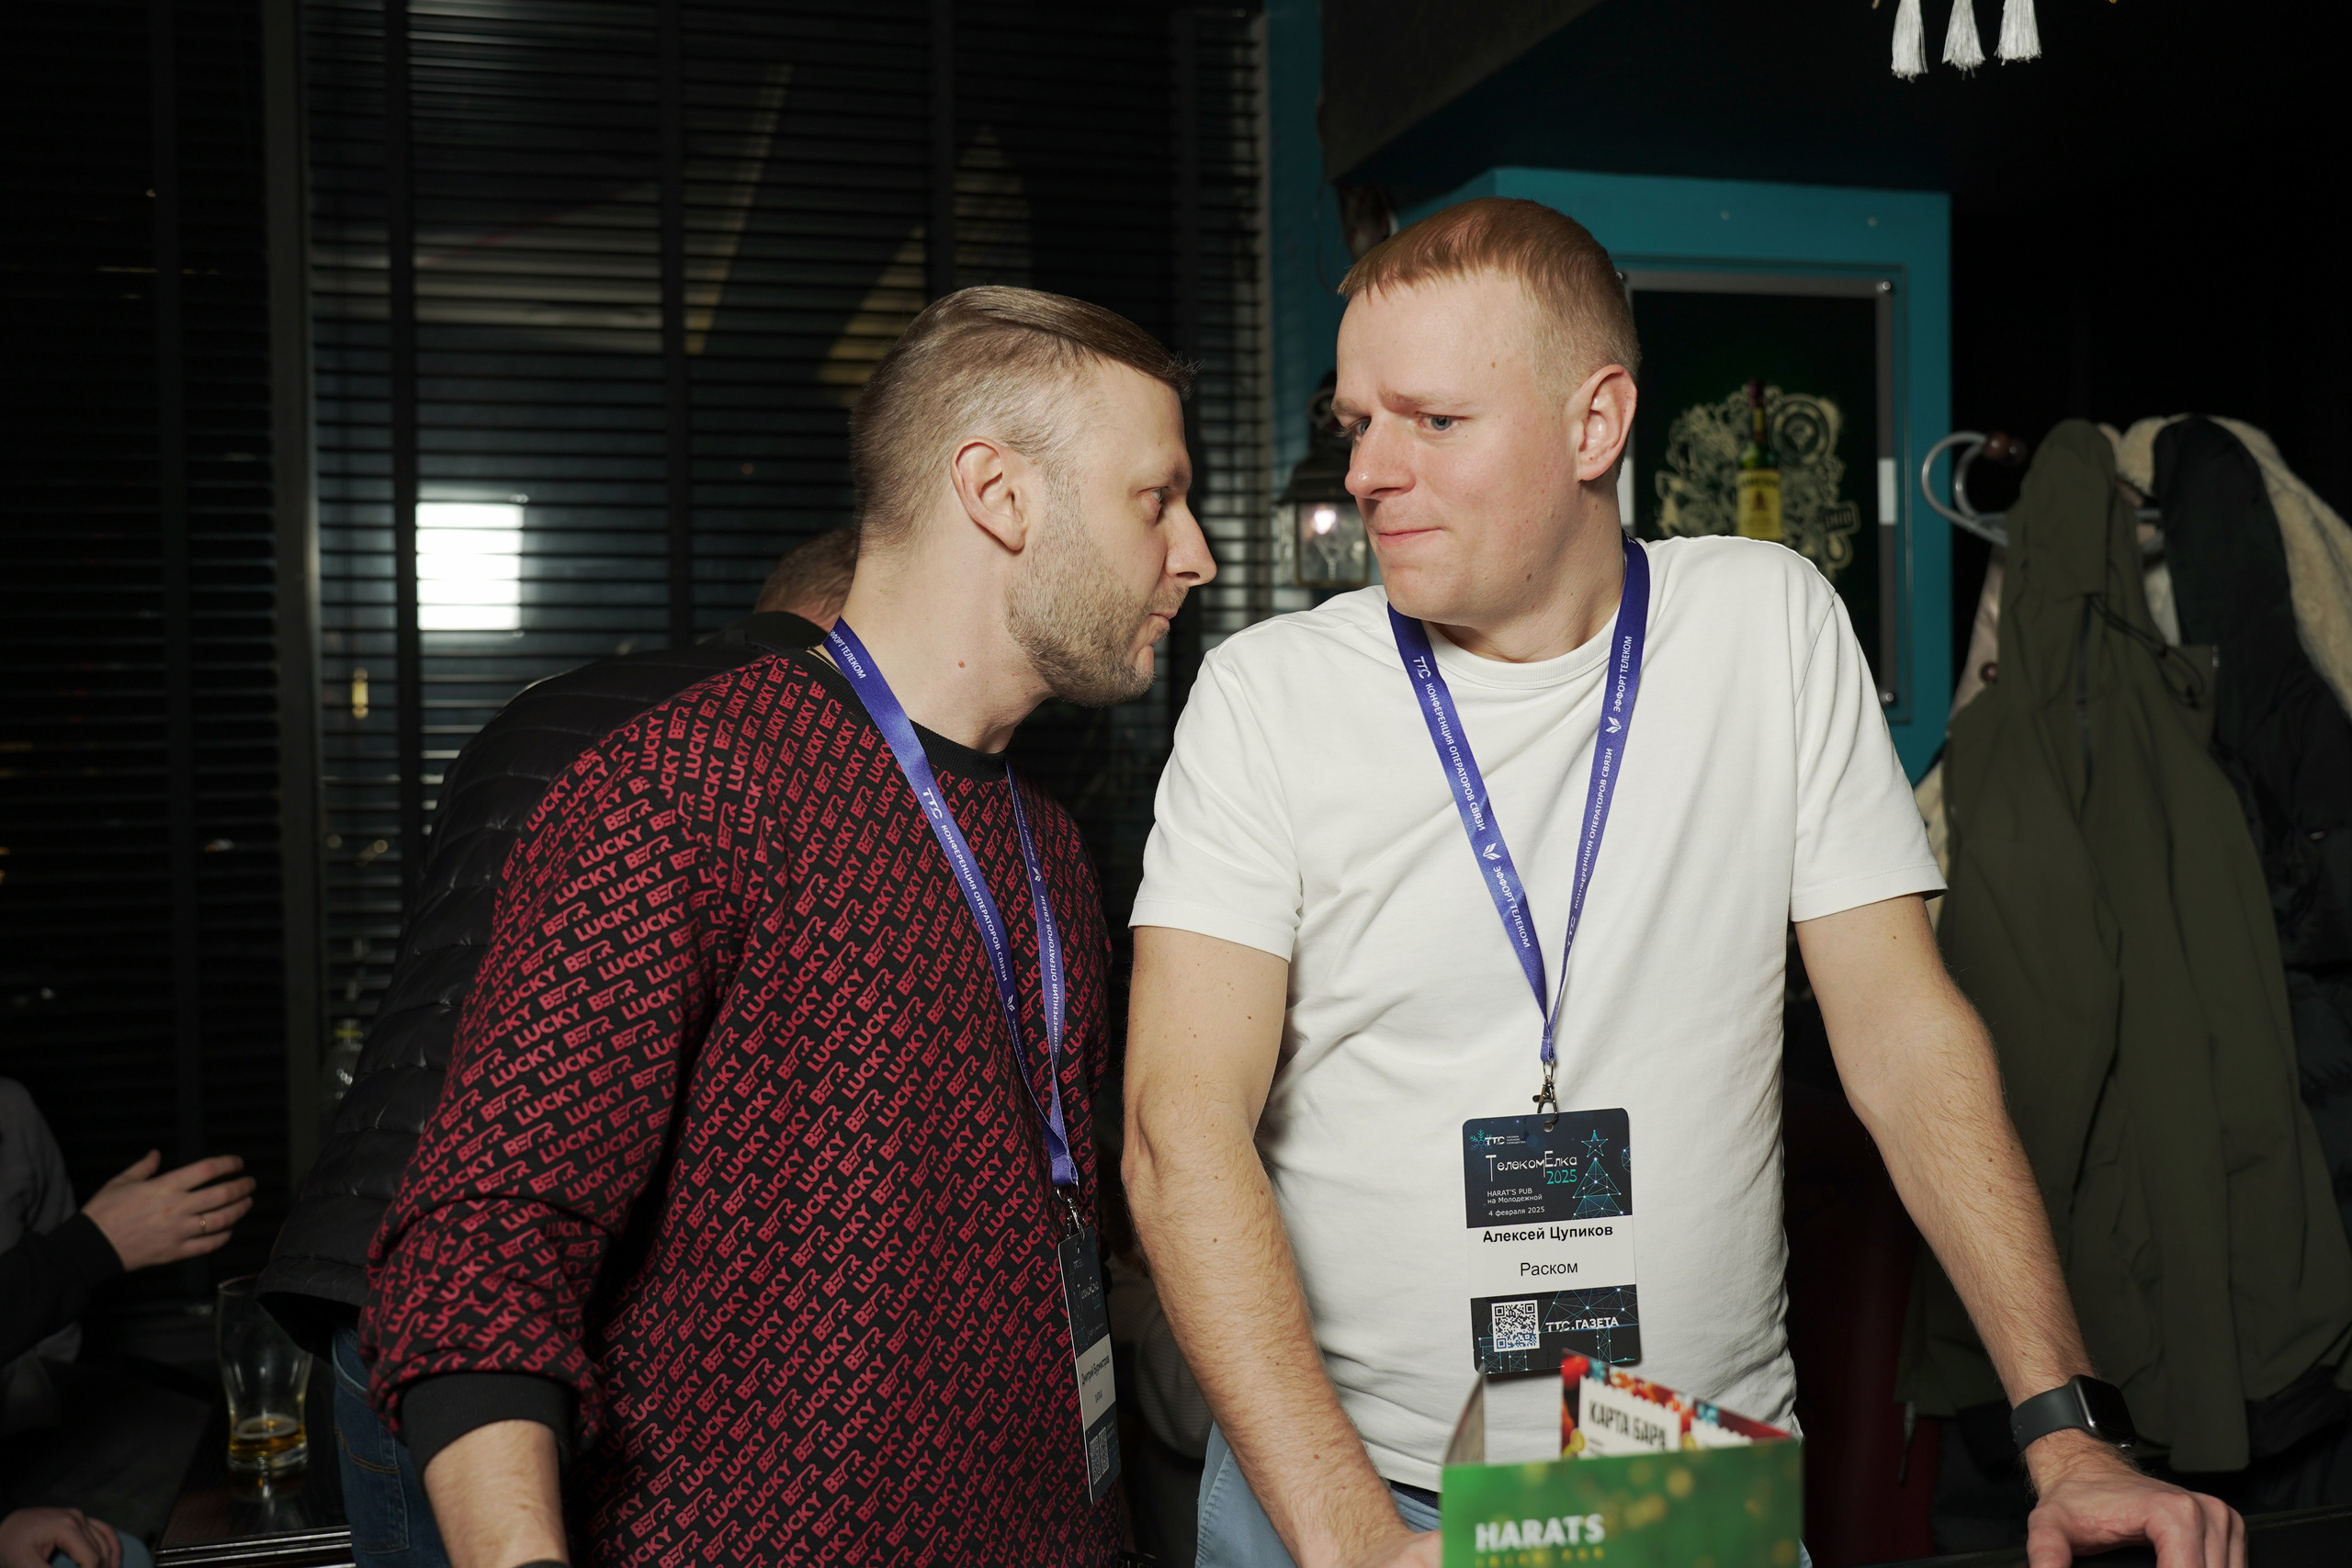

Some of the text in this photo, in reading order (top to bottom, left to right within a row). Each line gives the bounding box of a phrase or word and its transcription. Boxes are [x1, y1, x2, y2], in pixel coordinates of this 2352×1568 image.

[841, 645, 866, 679] ТЕЛЕКОМ
[1613, 636, 1633, 713] ЭФФОРТ ТЕЛЕКОМ
[639, 716, 664, 772] LUCKY
[684, 718, 710, 780] LUCKY
[801, 728, 828, 767] LUCKY
[829, 718, 857, 760] LUCKY
[1426, 682, 1454, 746] КОНФЕРЕНЦИЯ
[1449, 746, 1475, 801] ОПЕРАТОРОВ
[1470, 802, 1487, 831] СВЯЗИ
[698, 754, 725, 822] LUCKY
[837, 750, 865, 793] LUCKY
[578, 825, 641, 868] LUCKY
[1575, 840, 1593, 909] КОНФЕРЕНЦИЯ
[1589, 780, 1607, 839] ОПЕРАТОРОВ
[1601, 748, 1613, 778] СВЯЗИ
[554, 861, 617, 905] LUCKY
[941, 825, 977, 890] КОНФЕРЕНЦИЯ
[974, 891, 1001, 950] ОПЕРАТОРОВ
[997, 951, 1008, 981] СВЯЗИ
[1493, 865, 1531, 948] ЭФФОРТ ТЕЛЕКОМ
[491, 932, 535, 987] LUCKY
[599, 862, 662, 907] LUCKY
[573, 899, 639, 942] LUCKY
[782, 942, 830, 1004] LUCKY
[859, 842, 891, 894] LUCKY
[892, 908, 927, 963] LUCKY
[498, 964, 556, 1015] LUCKY
[622, 902, 684, 944] LUCKY
[774, 986, 822, 1047] LUCKY
[858, 880, 896, 935] LUCKY
[1046, 924, 1057, 982] ОПЕРАТОРОВ
[474, 1003, 531, 1055] LUCKY
[597, 939, 662, 981] LUCKY
[514, 1003, 581, 1049] LUCKY
[490, 1040, 556, 1088] LUCKY
[621, 979, 683, 1021] LUCKY
[727, 1080, 777, 1141] LUCKY
[813, 968, 864, 1029] LUCKY
[807, 1011, 856, 1072] LUCKY
[883, 1023, 928, 1083] LUCKY
[696, 1054, 741, 1112] LUCKY
[762, 1105, 811, 1168] LUCKY
[848, 995, 897, 1055] LUCKY
[842, 1038, 891, 1100] LUCKY
[876, 1066, 922, 1127] LUCKY
[419, 1116, 474, 1172] LUCKY
[538, 1042, 604, 1086] LUCKY
[514, 1079, 582, 1126] LUCKY
[689, 1097, 735, 1156] LUCKY
[940, 1082, 982, 1139] LUCKY
[539, 1120, 604, 1164] LUCKY
[720, 1123, 770, 1184] LUCKY
[966, 1111, 1009, 1168] LUCKY
[430, 1150, 494, 1201] LUCKY
[565, 1158, 616, 1201] LUCKY
[741, 1267, 791, 1326] LUCKY
[830, 1159, 879, 1220] LUCKY
[915, 1052, 955, 1111] LUCKY
[1487, 1189, 1517, 1197] HARAT'S
[1498, 1194, 1543, 1203] Молодежной
[1546, 1169, 1577, 1184] 2025
[788, 1175, 838, 1235] LUCKY
[862, 1188, 910, 1249] LUCKY
[984, 1180, 1029, 1236] LUCKY
[1484, 1225, 1613, 1243] Алексей Цупиков
[1495, 1208, 1526, 1217] февраля
[661, 1226, 689, 1274] LUCKY
[710, 1242, 757, 1300] LUCKY
[895, 1216, 935, 1277] LUCKY
[1520, 1261, 1578, 1277] Раском
[732, 1310, 784, 1369] LUCKY
[822, 1203, 871, 1264] LUCKY
[972, 1295, 1009, 1355] LUCKY
[691, 1399, 736, 1452] LUCKY
[775, 1295, 821, 1354] LUCKY
[767, 1339, 811, 1396] LUCKY
[803, 1325, 853, 1385] LUCKY
[793, 1370, 842, 1428] LUCKY
[833, 1354, 886, 1416] LUCKY
[1589, 1400, 1629, 1436] КАРТА
[1633, 1416, 1667, 1450] БАРА
[680, 1440, 729, 1495] LUCKY
[856, 1426, 904, 1488] LUCKY
[925, 1431, 964, 1494] LUCKY
[706, 1470, 754, 1528] LUCKY
[744, 1459, 791, 1517] LUCKY
[914, 1476, 958, 1539] LUCKY
[731, 1504, 780, 1562] LUCKY
